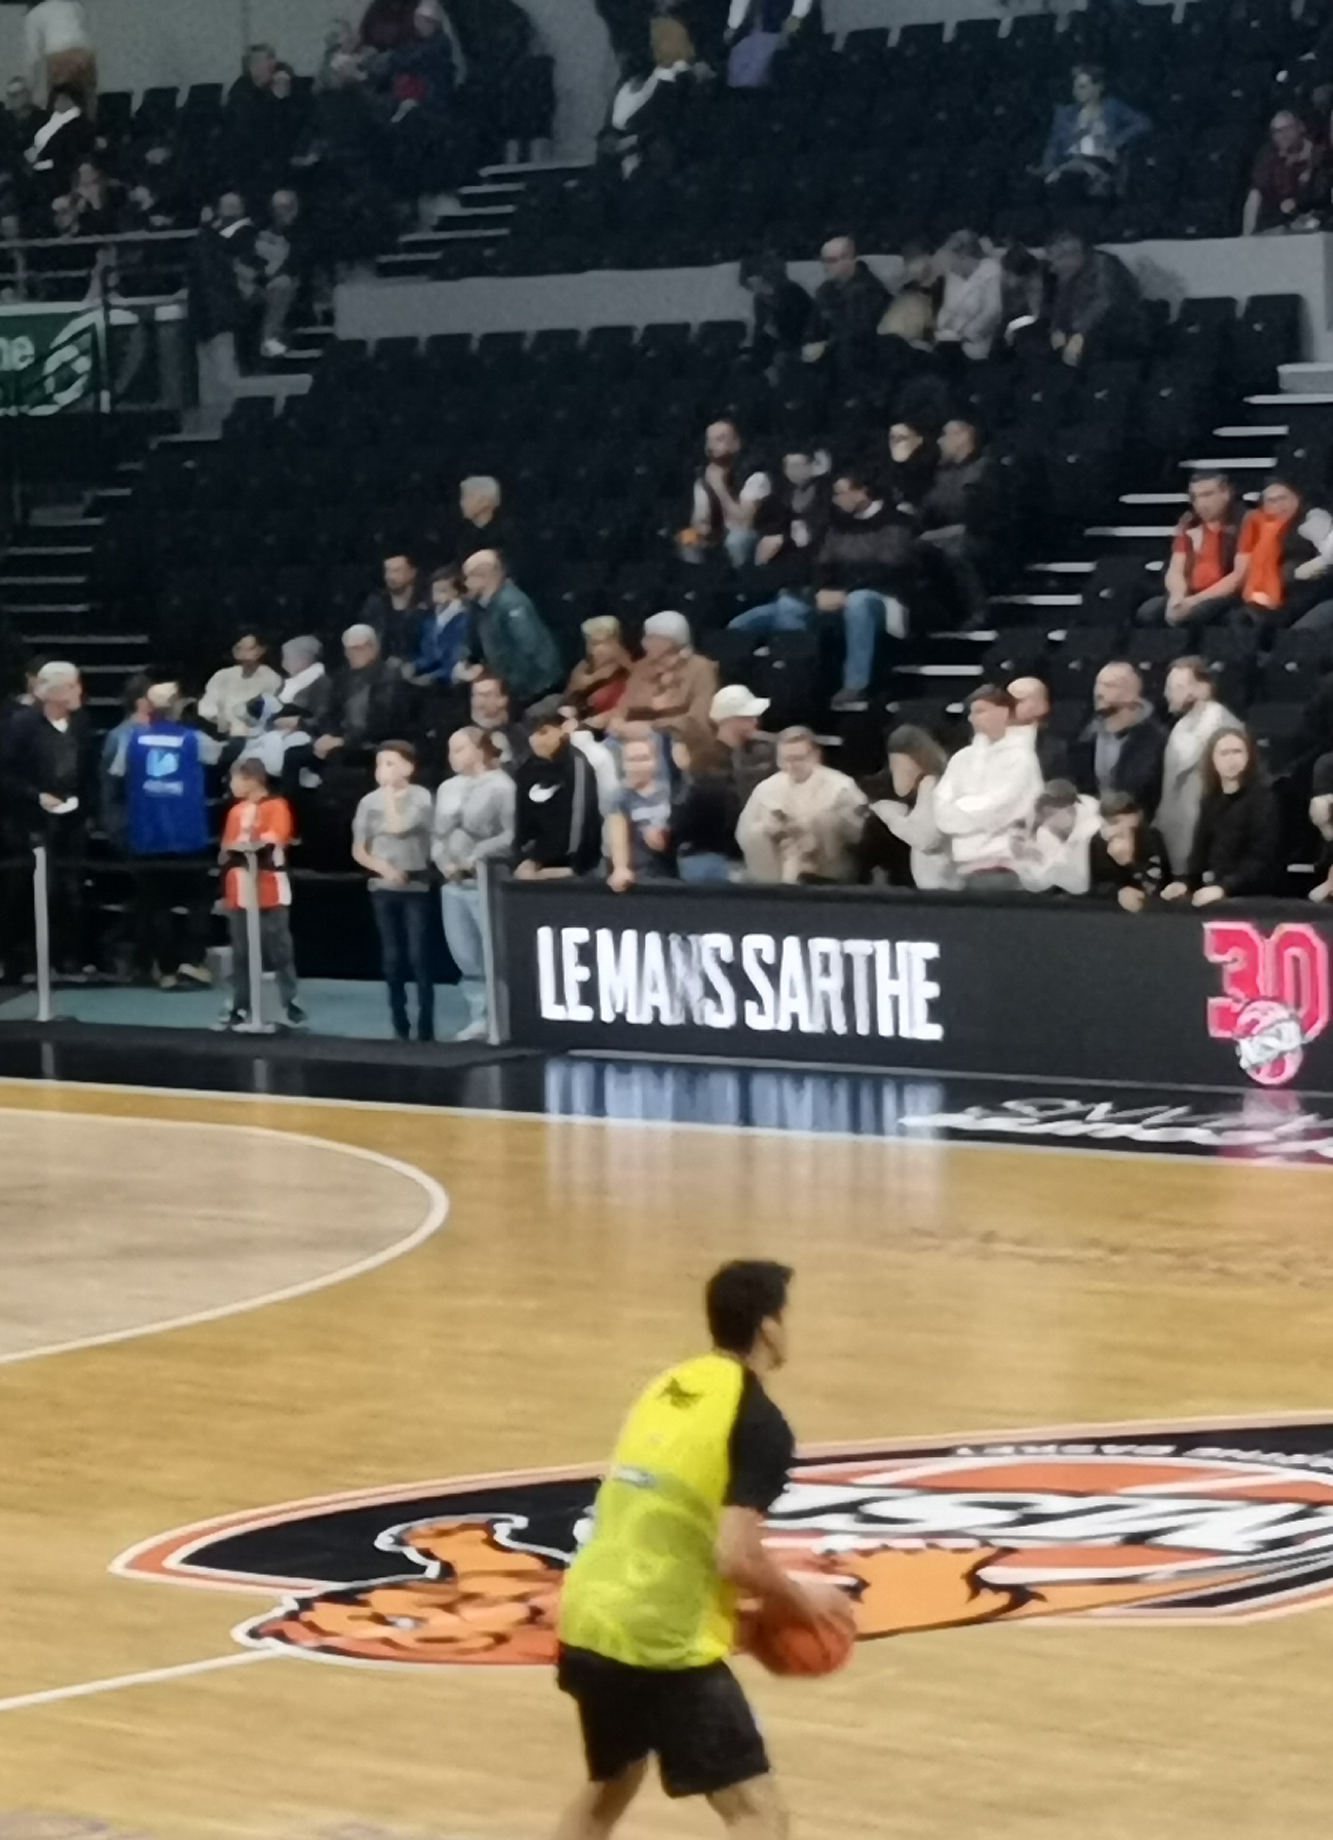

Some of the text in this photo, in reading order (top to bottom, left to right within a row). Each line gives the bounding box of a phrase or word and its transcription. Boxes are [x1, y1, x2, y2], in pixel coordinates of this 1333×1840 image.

[537, 925, 944, 1042] LE MANS SARTHE
[1202, 921, 1330, 1038] 30
